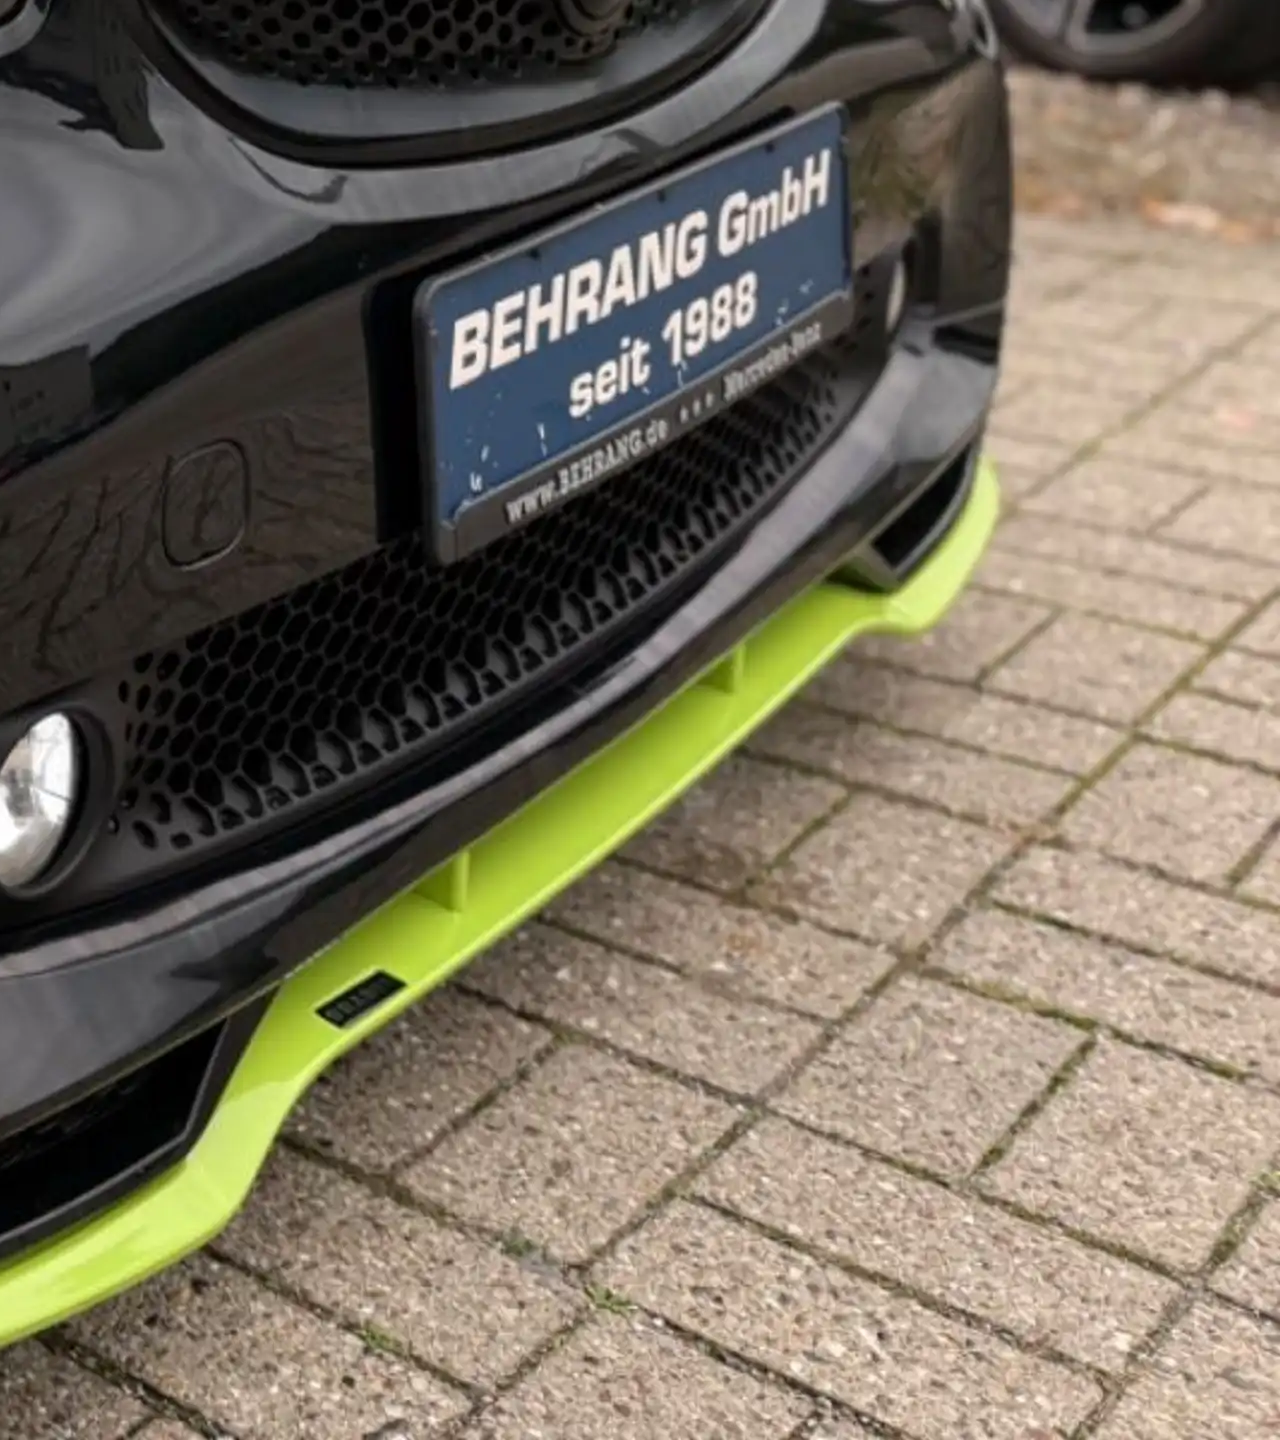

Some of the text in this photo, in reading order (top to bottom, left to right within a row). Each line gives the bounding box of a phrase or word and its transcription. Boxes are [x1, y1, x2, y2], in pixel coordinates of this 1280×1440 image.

[449, 149, 831, 390] BEHRANG GmbH
[569, 271, 758, 418] seit 1988
[506, 418, 669, 523] www.BEHRANG.de
